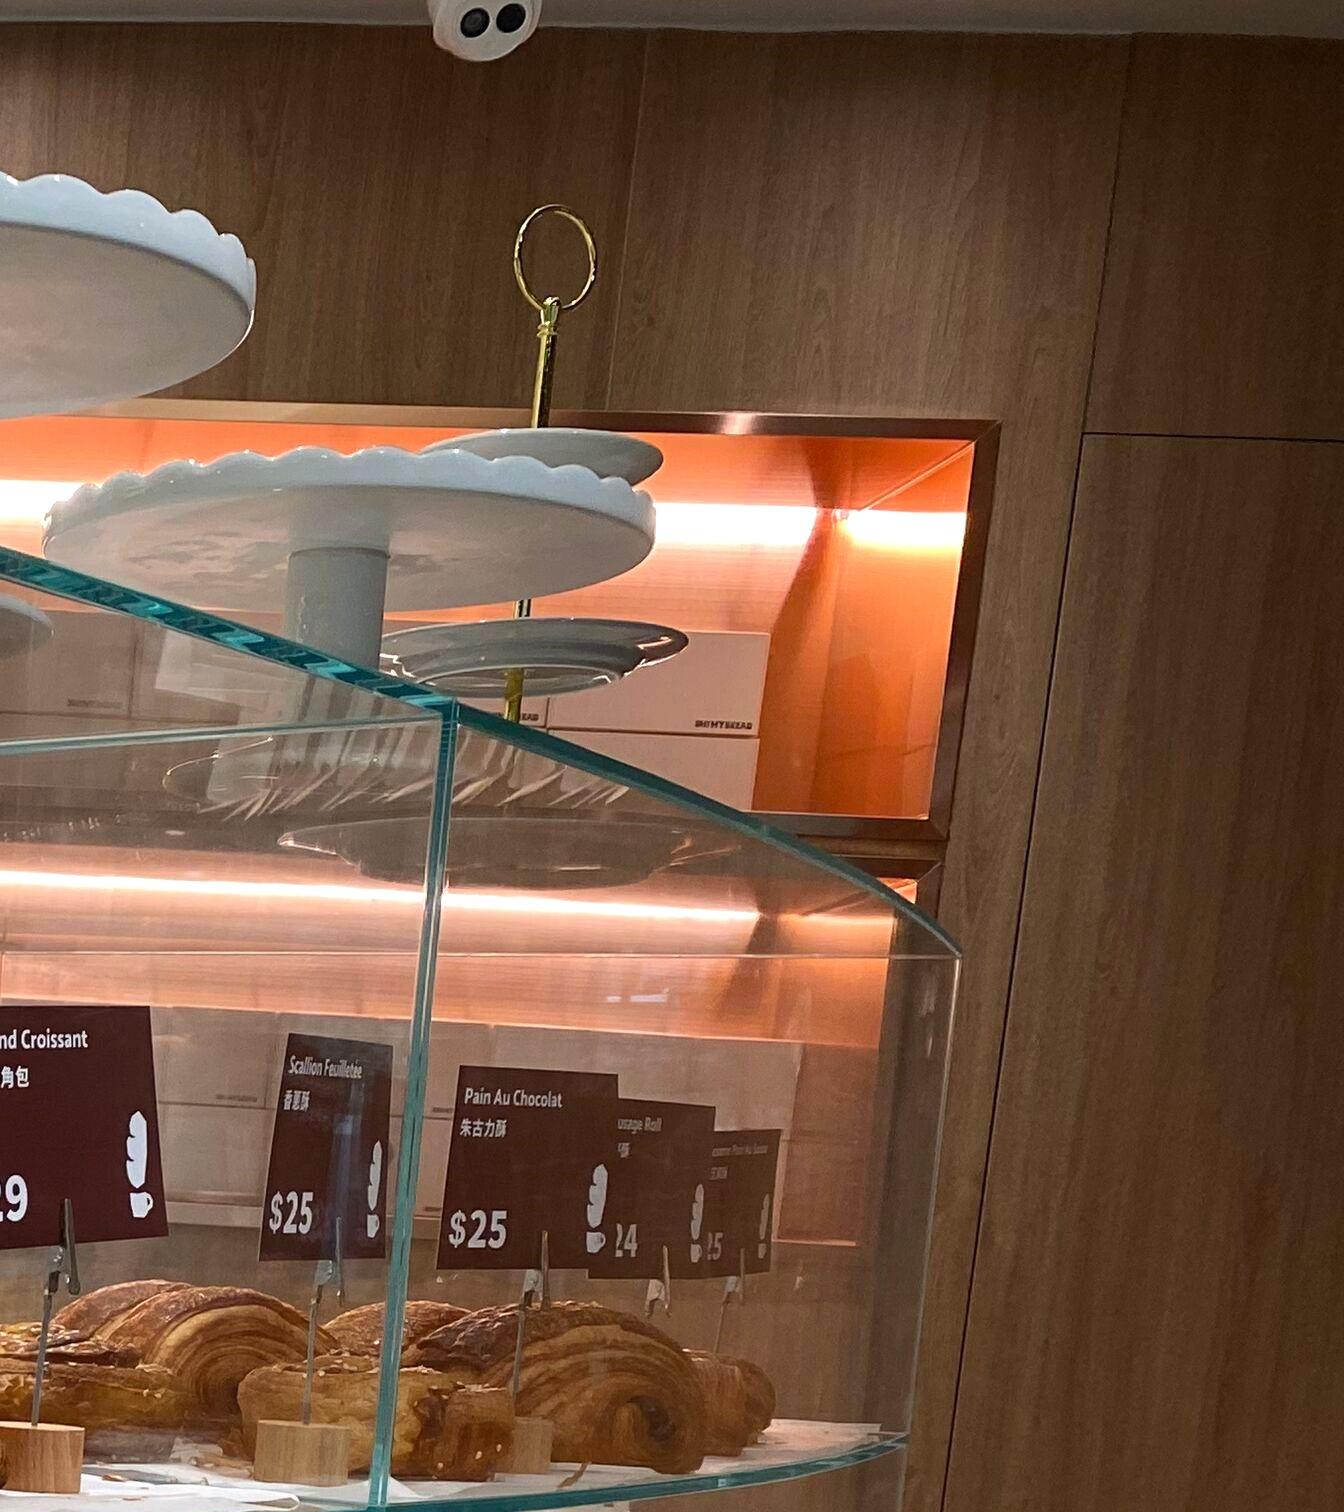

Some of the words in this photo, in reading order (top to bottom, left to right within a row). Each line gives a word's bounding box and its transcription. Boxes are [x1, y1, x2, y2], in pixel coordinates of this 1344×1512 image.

[21, 1028, 89, 1049] Croissant
[464, 1087, 491, 1105] Pain
[493, 1088, 511, 1106] Au
[513, 1089, 563, 1109] Chocolat
[268, 1190, 314, 1236] $25
[448, 1210, 508, 1250] $25
